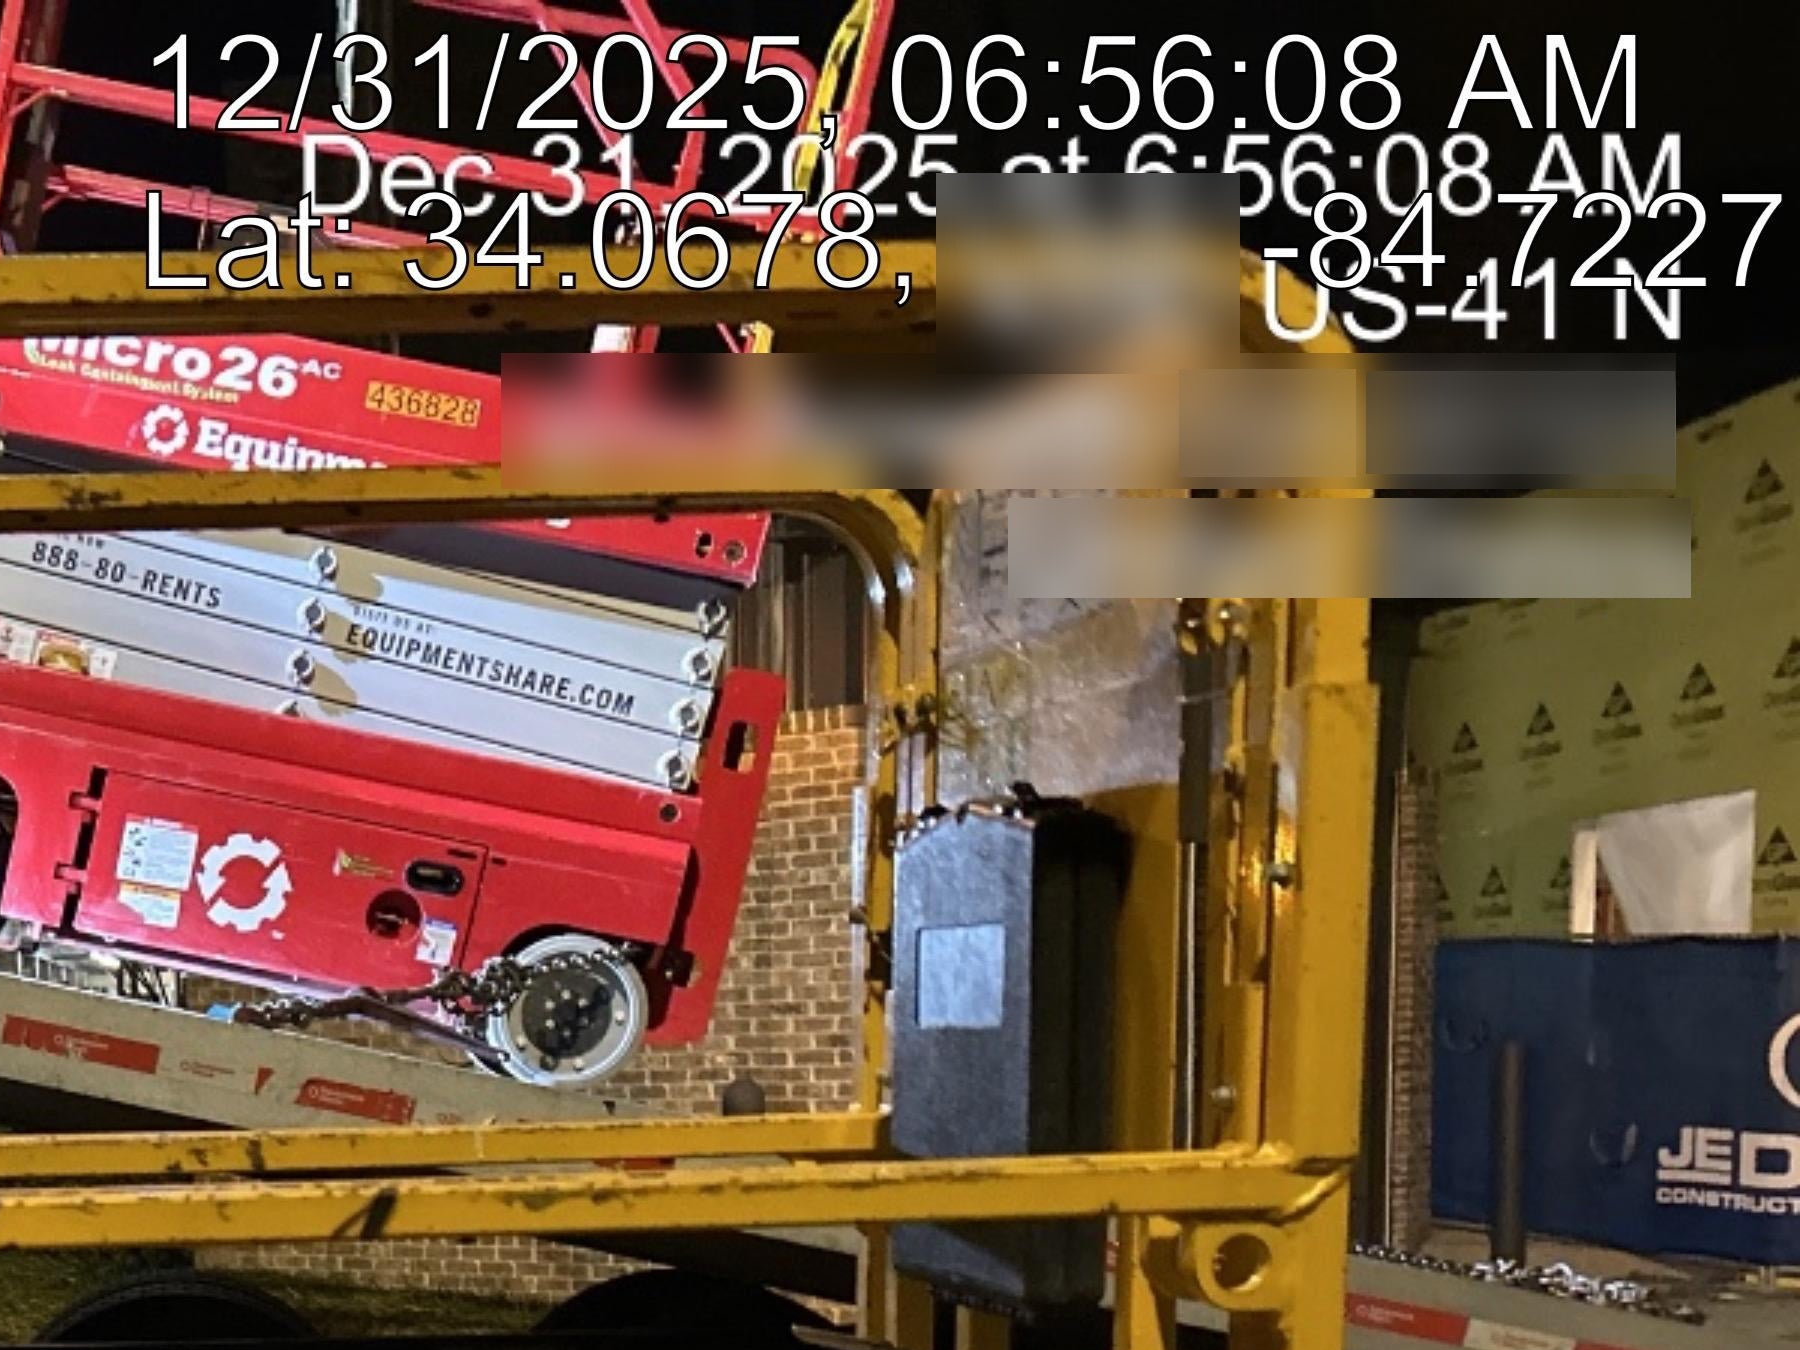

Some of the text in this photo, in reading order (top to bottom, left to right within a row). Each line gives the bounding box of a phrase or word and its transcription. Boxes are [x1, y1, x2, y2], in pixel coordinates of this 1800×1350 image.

[302, 358, 342, 381] AC
[368, 383, 478, 424] 436828
[31, 542, 221, 608] 888-80-RENTS
[346, 622, 634, 716] EQUIPMENTSHARE.COM
